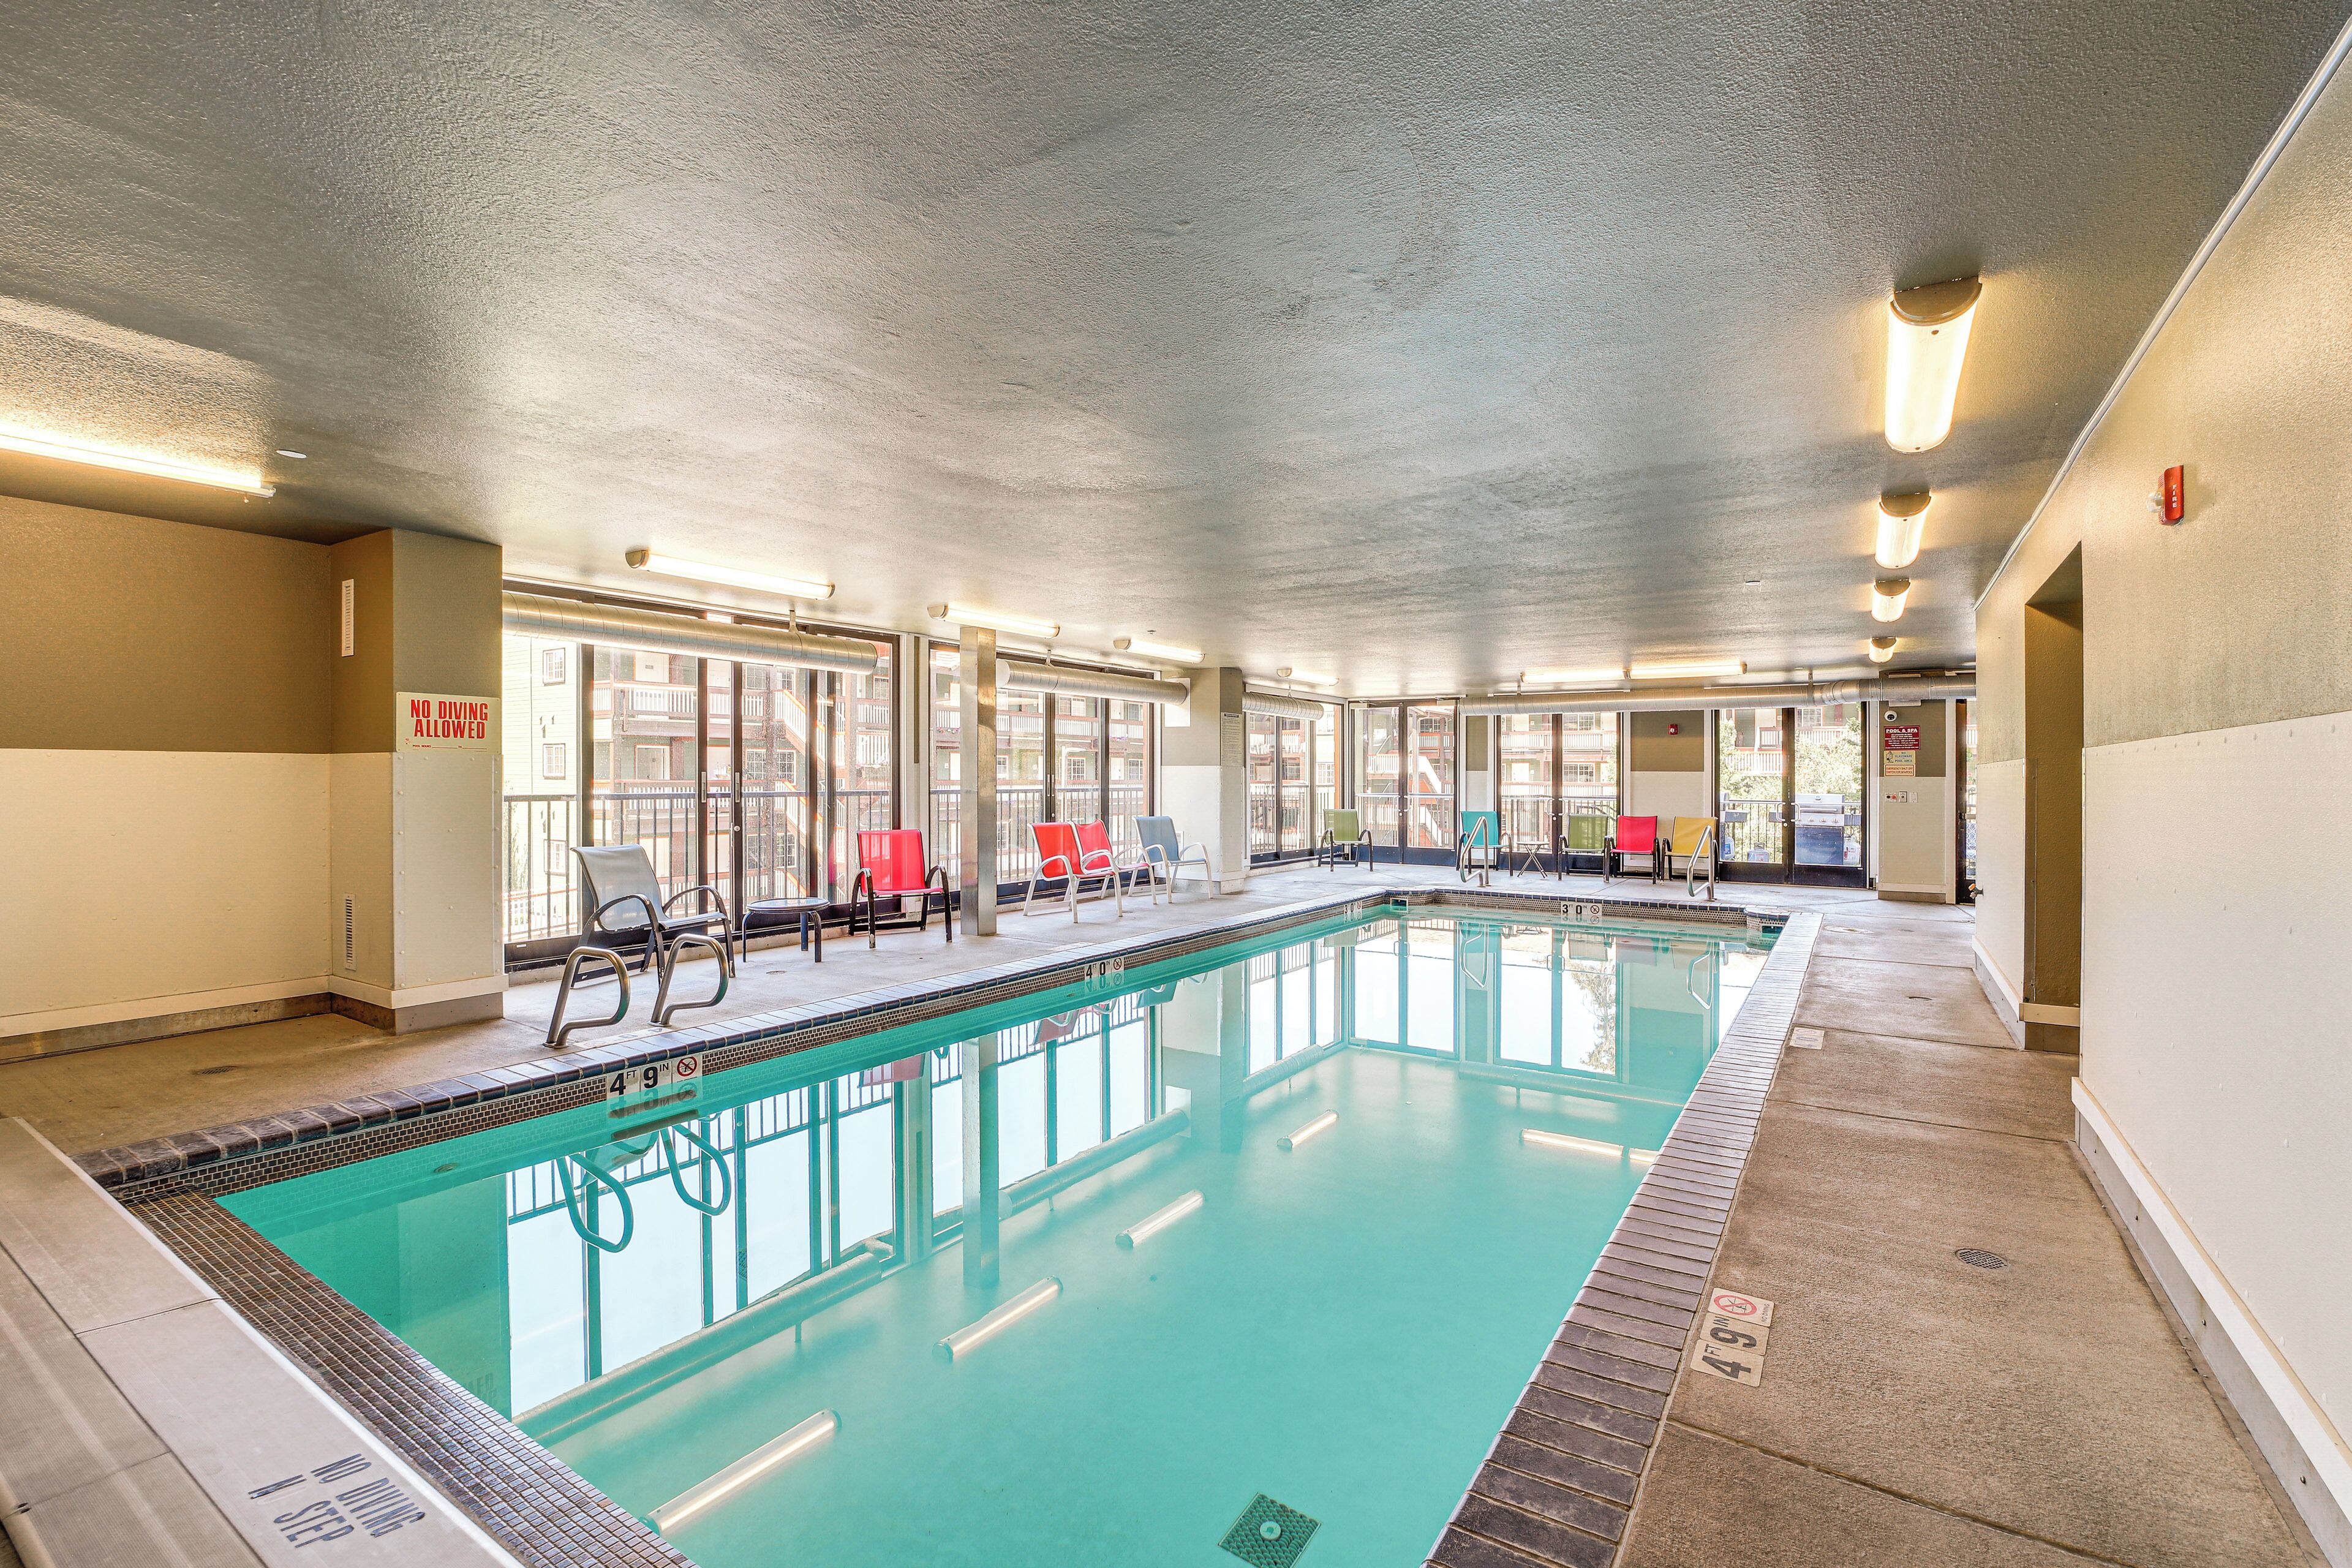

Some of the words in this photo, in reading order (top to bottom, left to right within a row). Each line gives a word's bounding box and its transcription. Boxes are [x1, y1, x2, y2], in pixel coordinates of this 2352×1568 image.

[411, 699, 431, 718] NO
[439, 701, 488, 721] DIVING
[414, 719, 485, 739] ALLOWED
[1562, 904, 1569, 913] 3
[1576, 905, 1582, 914] 0
[1086, 965, 1093, 979] 4
[1099, 962, 1106, 976] 0
[609, 1072, 626, 1095] 4
[627, 1070, 637, 1079] FT
[643, 1066, 658, 1089] 9
[660, 1063, 669, 1072] IN
[1713, 1316, 1730, 1327] IN
[1710, 1327, 1757, 1348] 9
[1705, 1344, 1722, 1356] FT
[1702, 1355, 1751, 1379] 4
[311, 1453, 372, 1483] NO
[335, 1477, 426, 1538] DIVING
[273, 1500, 355, 1548] STEP
